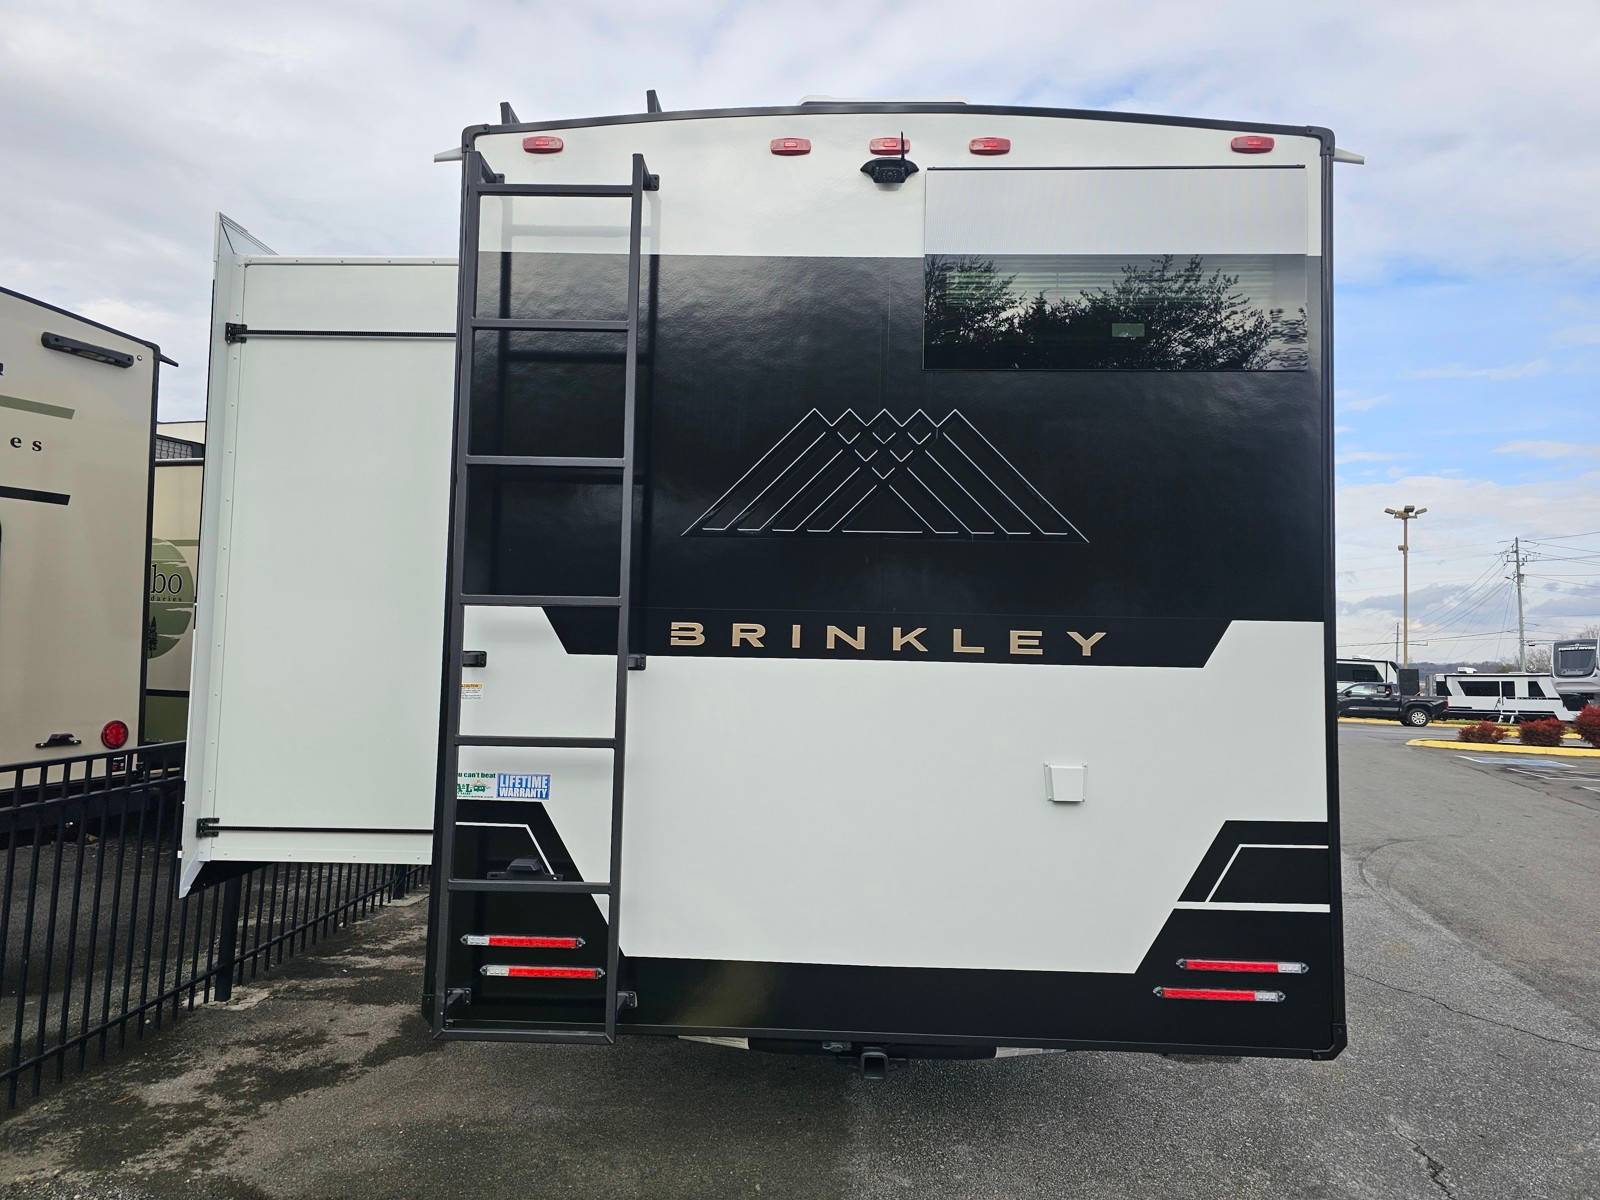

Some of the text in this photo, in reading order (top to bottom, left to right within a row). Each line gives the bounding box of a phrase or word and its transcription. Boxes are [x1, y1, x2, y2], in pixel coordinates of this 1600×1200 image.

[670, 621, 1108, 658] BRINKLEY
[500, 774, 548, 788] LIFETIME
[499, 787, 548, 798] WARRANTY
